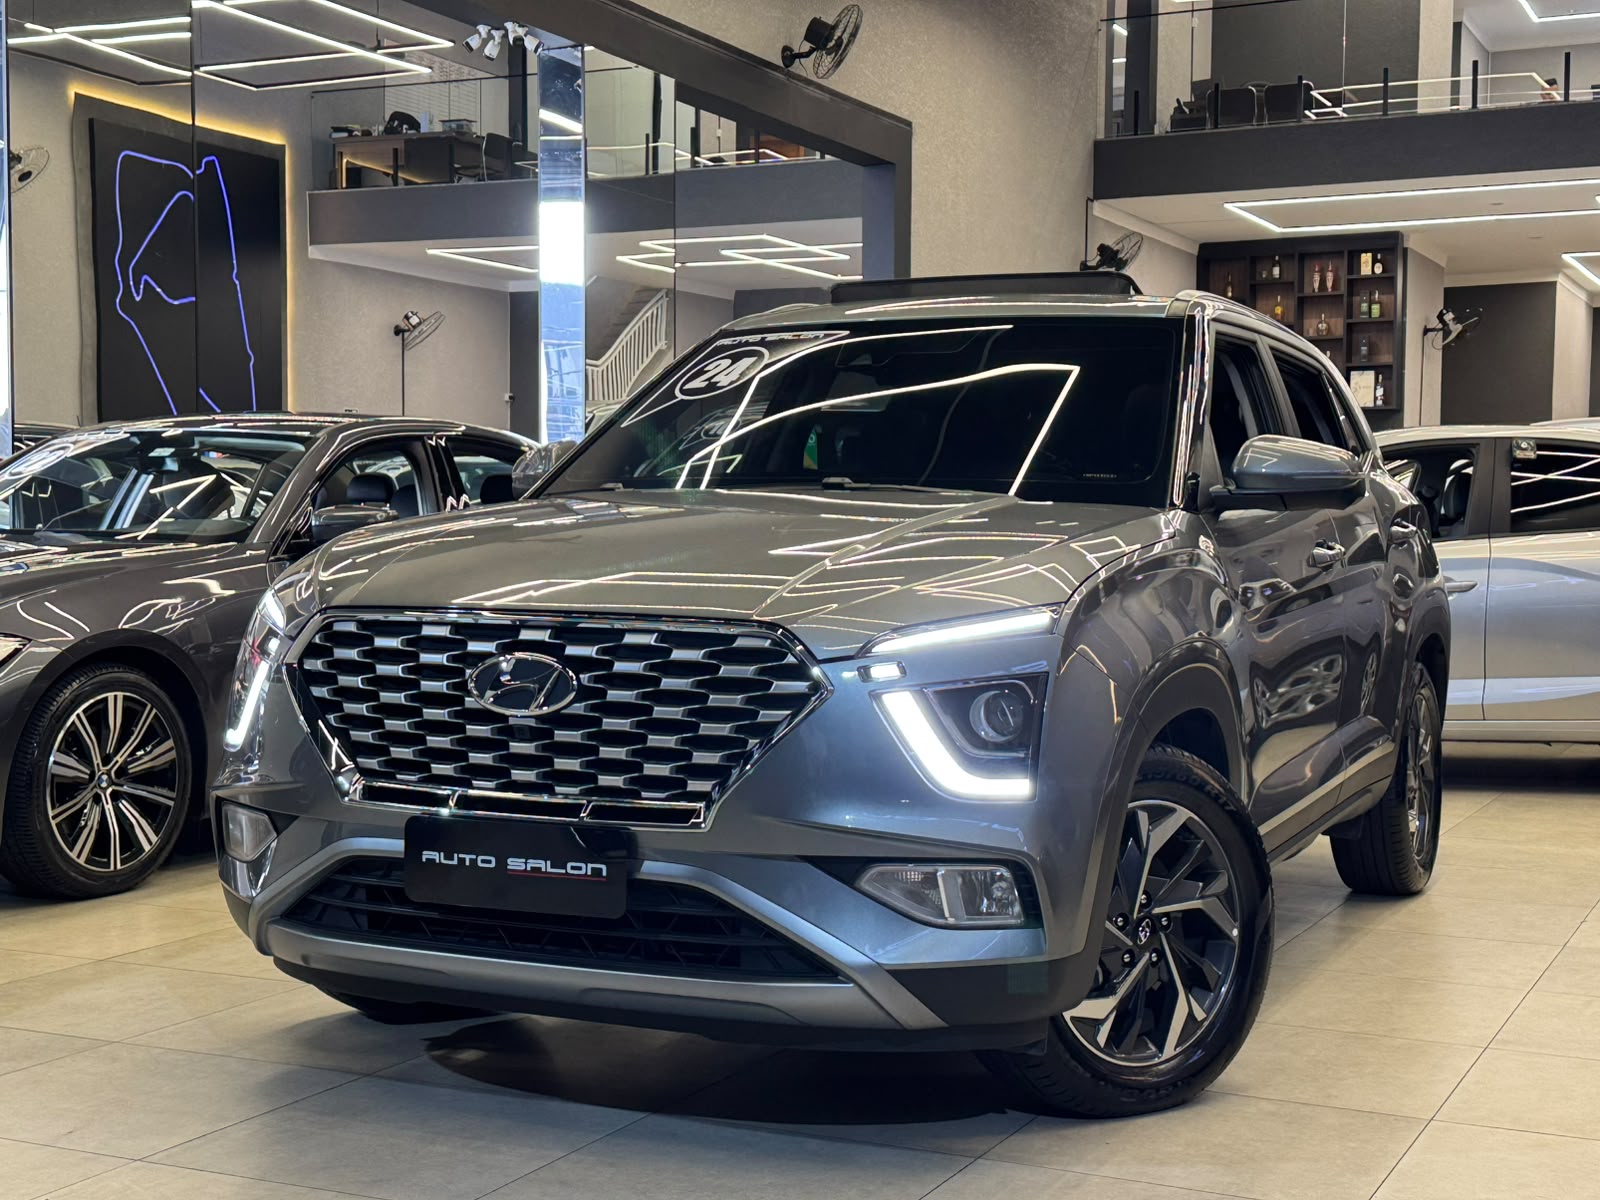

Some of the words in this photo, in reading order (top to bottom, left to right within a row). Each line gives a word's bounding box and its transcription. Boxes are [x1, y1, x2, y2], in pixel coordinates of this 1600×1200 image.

[683, 357, 758, 389] 24
[422, 850, 496, 868] AUTO
[507, 857, 607, 877] SALON
